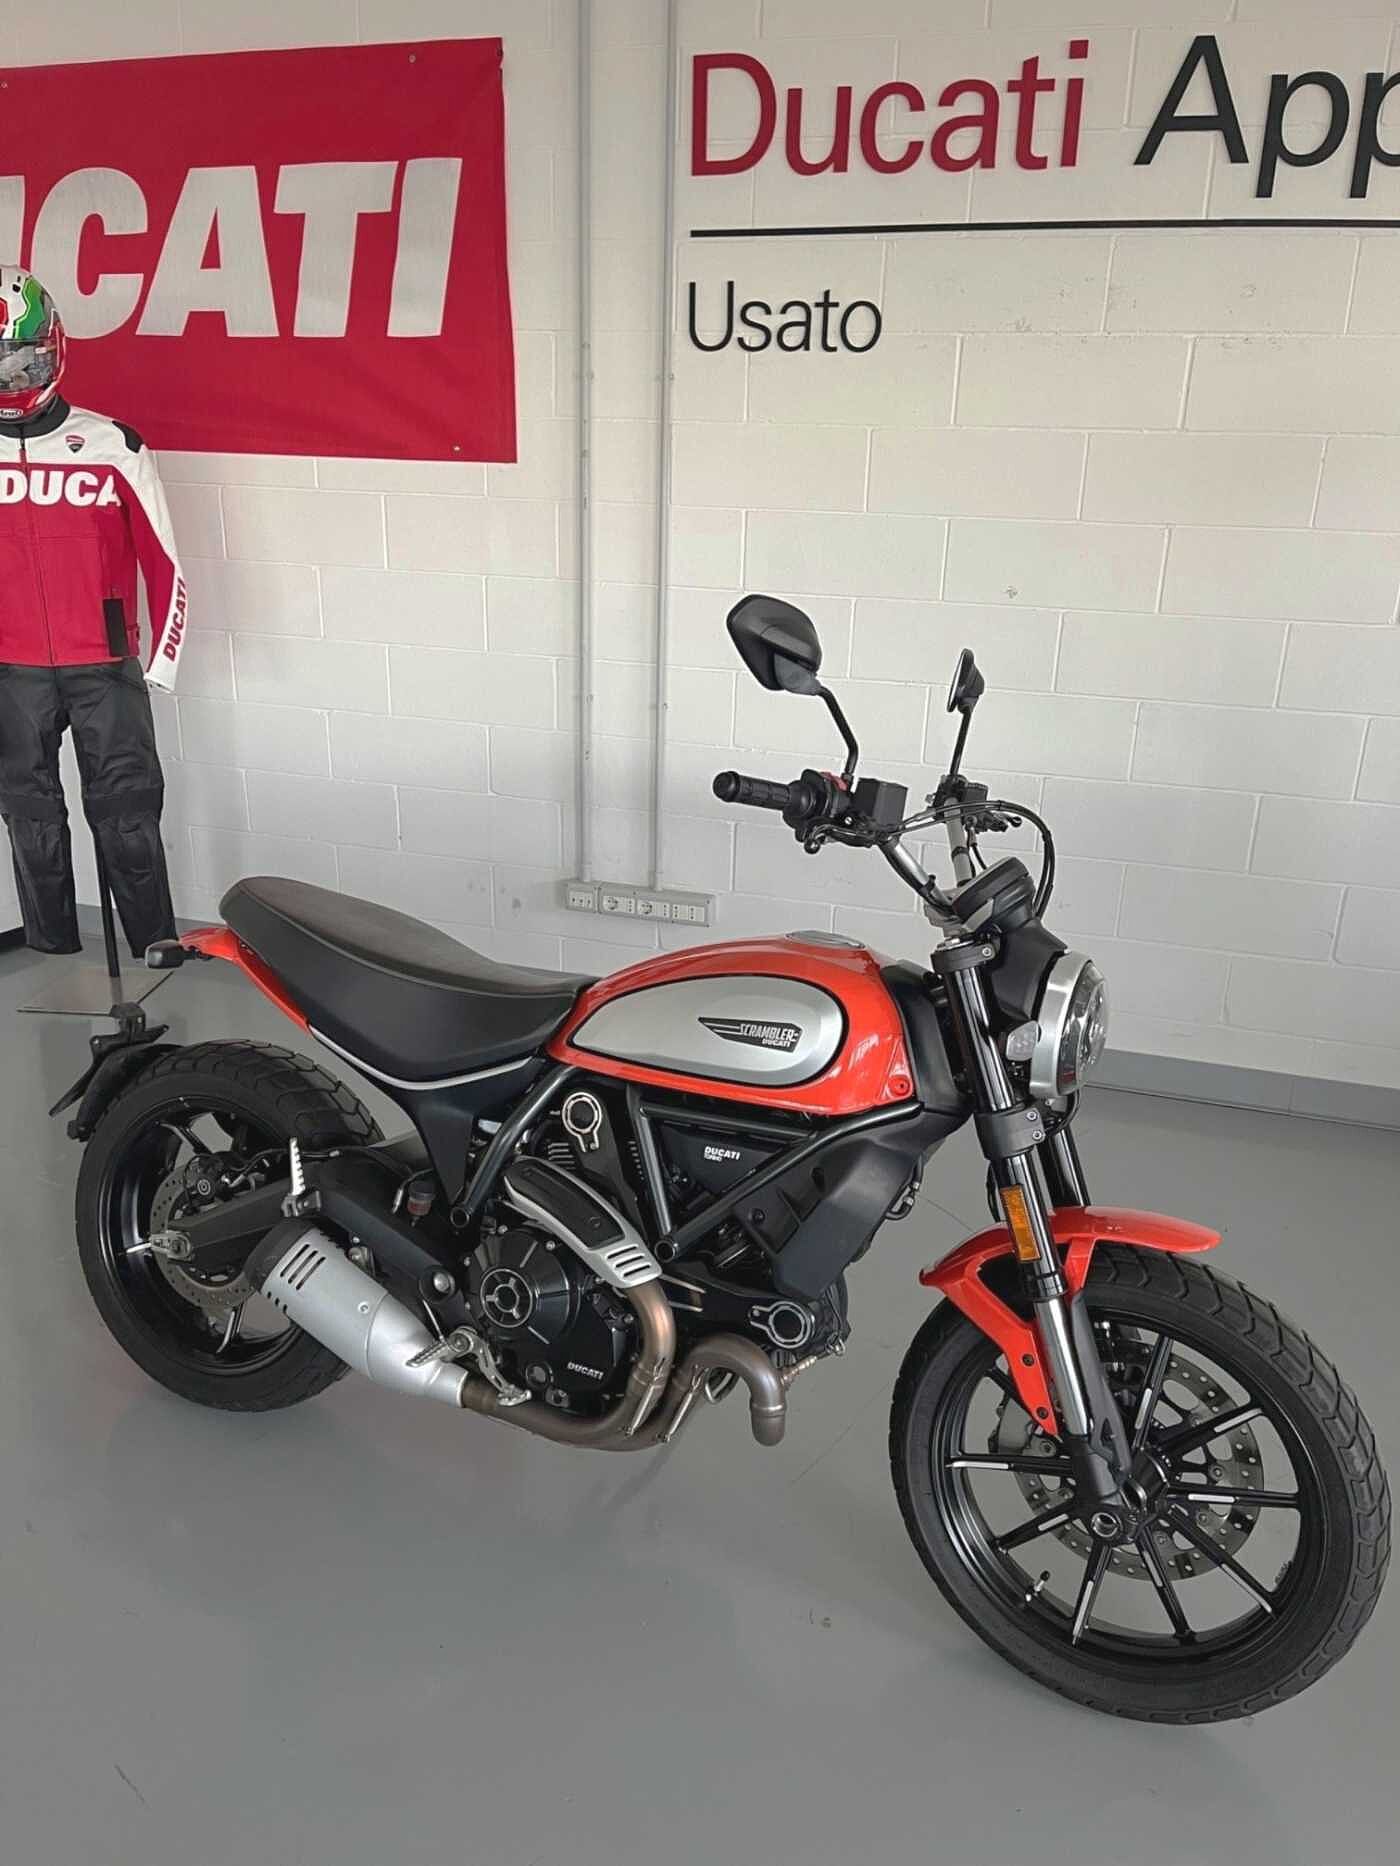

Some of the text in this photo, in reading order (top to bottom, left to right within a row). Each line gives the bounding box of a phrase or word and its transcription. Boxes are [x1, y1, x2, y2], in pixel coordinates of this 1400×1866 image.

[690, 39, 1089, 177] Ducati
[688, 280, 883, 353] Usato
[163, 576, 186, 662] DUCATI
[740, 1023, 795, 1042] SCRAMBLER
[704, 1146, 740, 1160] DUCATI
[567, 1361, 604, 1380] DUCATI
